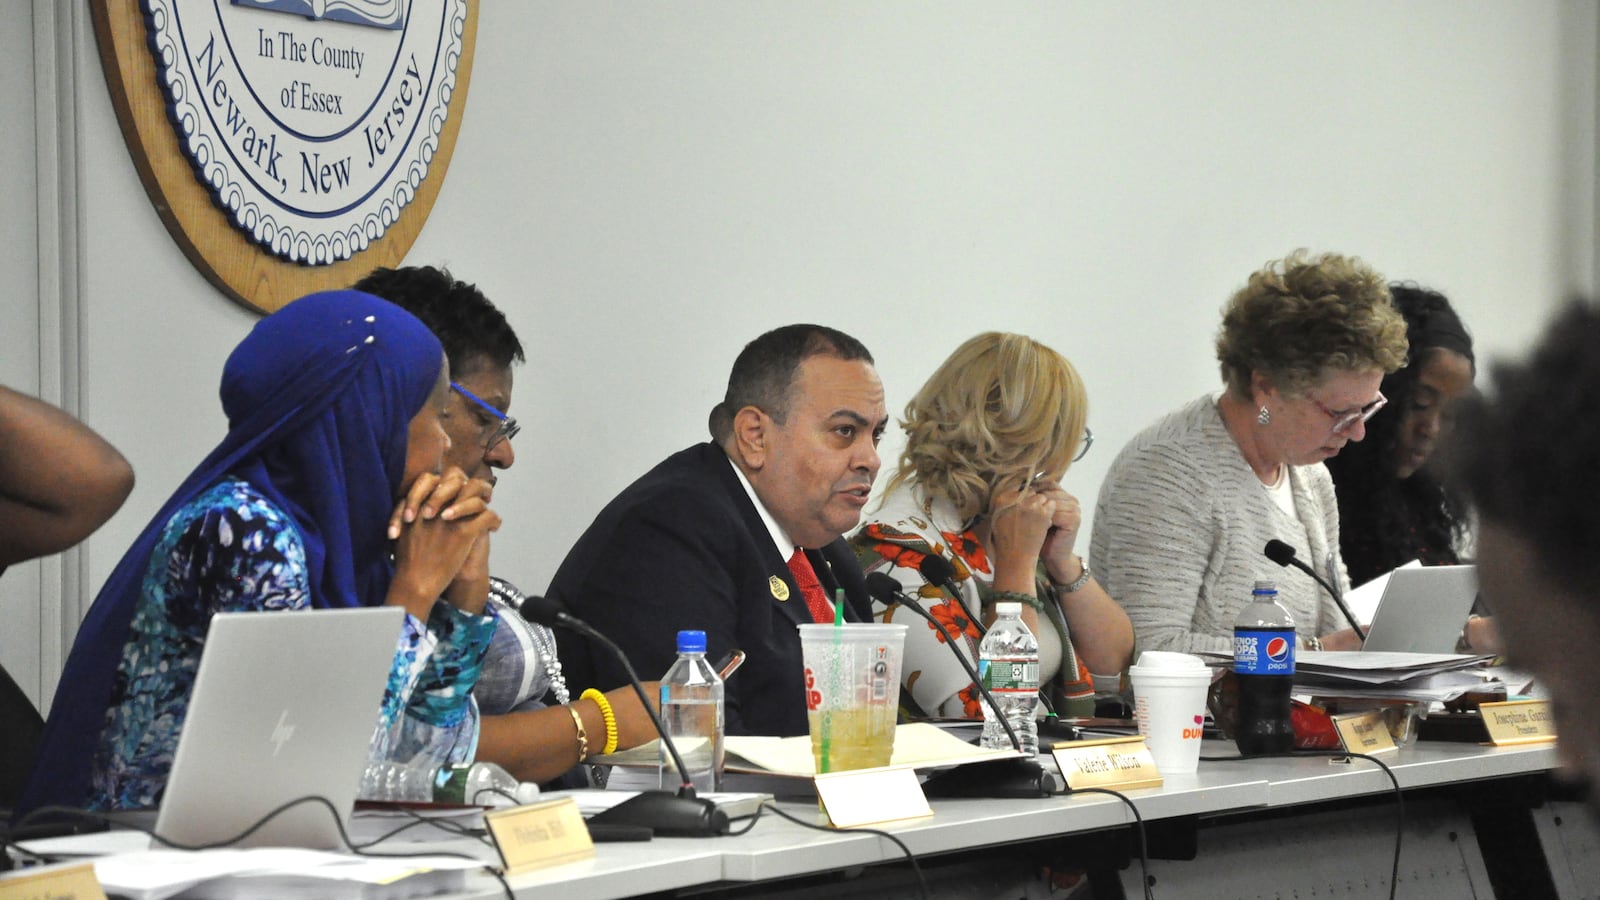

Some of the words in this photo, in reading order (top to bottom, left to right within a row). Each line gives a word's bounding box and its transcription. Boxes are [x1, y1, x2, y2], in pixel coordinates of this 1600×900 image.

[258, 28, 274, 58] In
[278, 31, 307, 63] The
[311, 36, 365, 79] County
[195, 30, 287, 195] Newark,
[299, 151, 351, 195] New
[363, 52, 423, 169] Jersey
[280, 80, 298, 109] of
[301, 82, 343, 115] Essex
[1074, 755, 1110, 774] Valerie
[1107, 753, 1142, 771] Wilson
